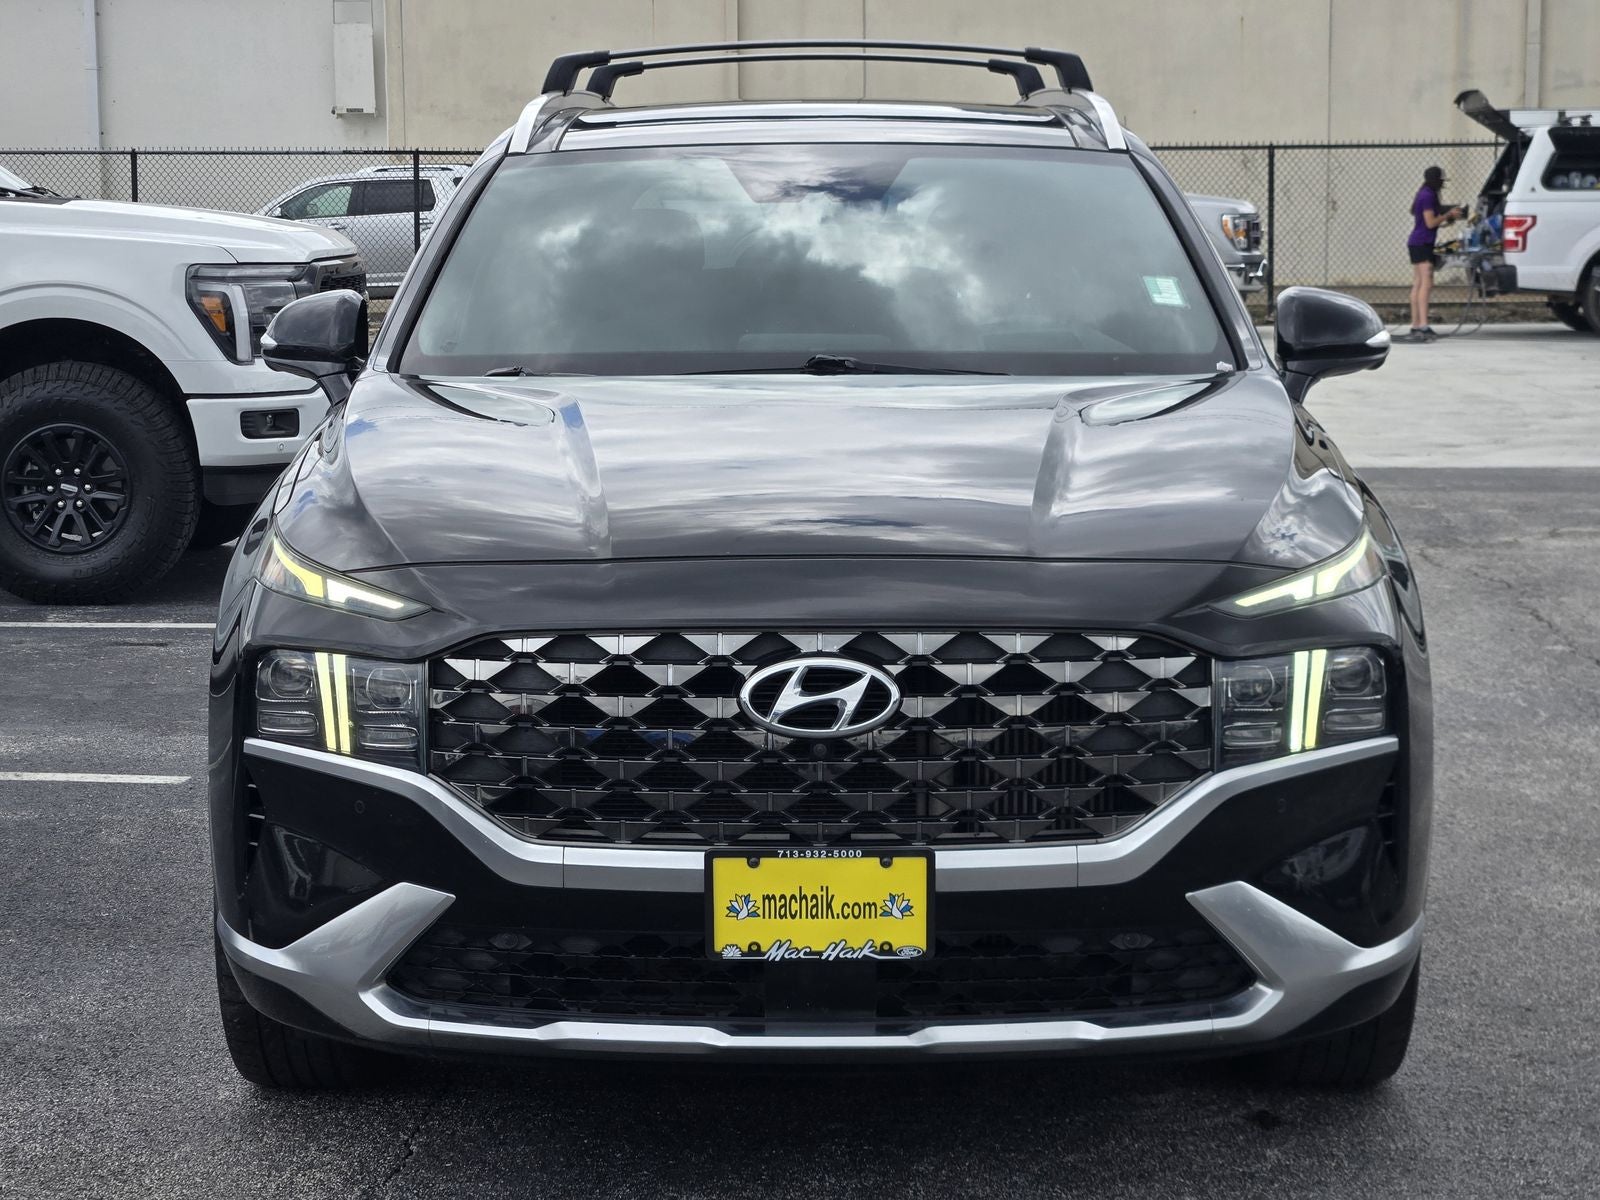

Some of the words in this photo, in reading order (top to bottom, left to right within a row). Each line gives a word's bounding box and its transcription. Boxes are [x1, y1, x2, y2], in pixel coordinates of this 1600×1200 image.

[777, 849, 862, 858] 713-932-5000
[762, 885, 878, 920] machaik.com
[764, 939, 815, 961] Mac
[821, 939, 877, 961] Haik
